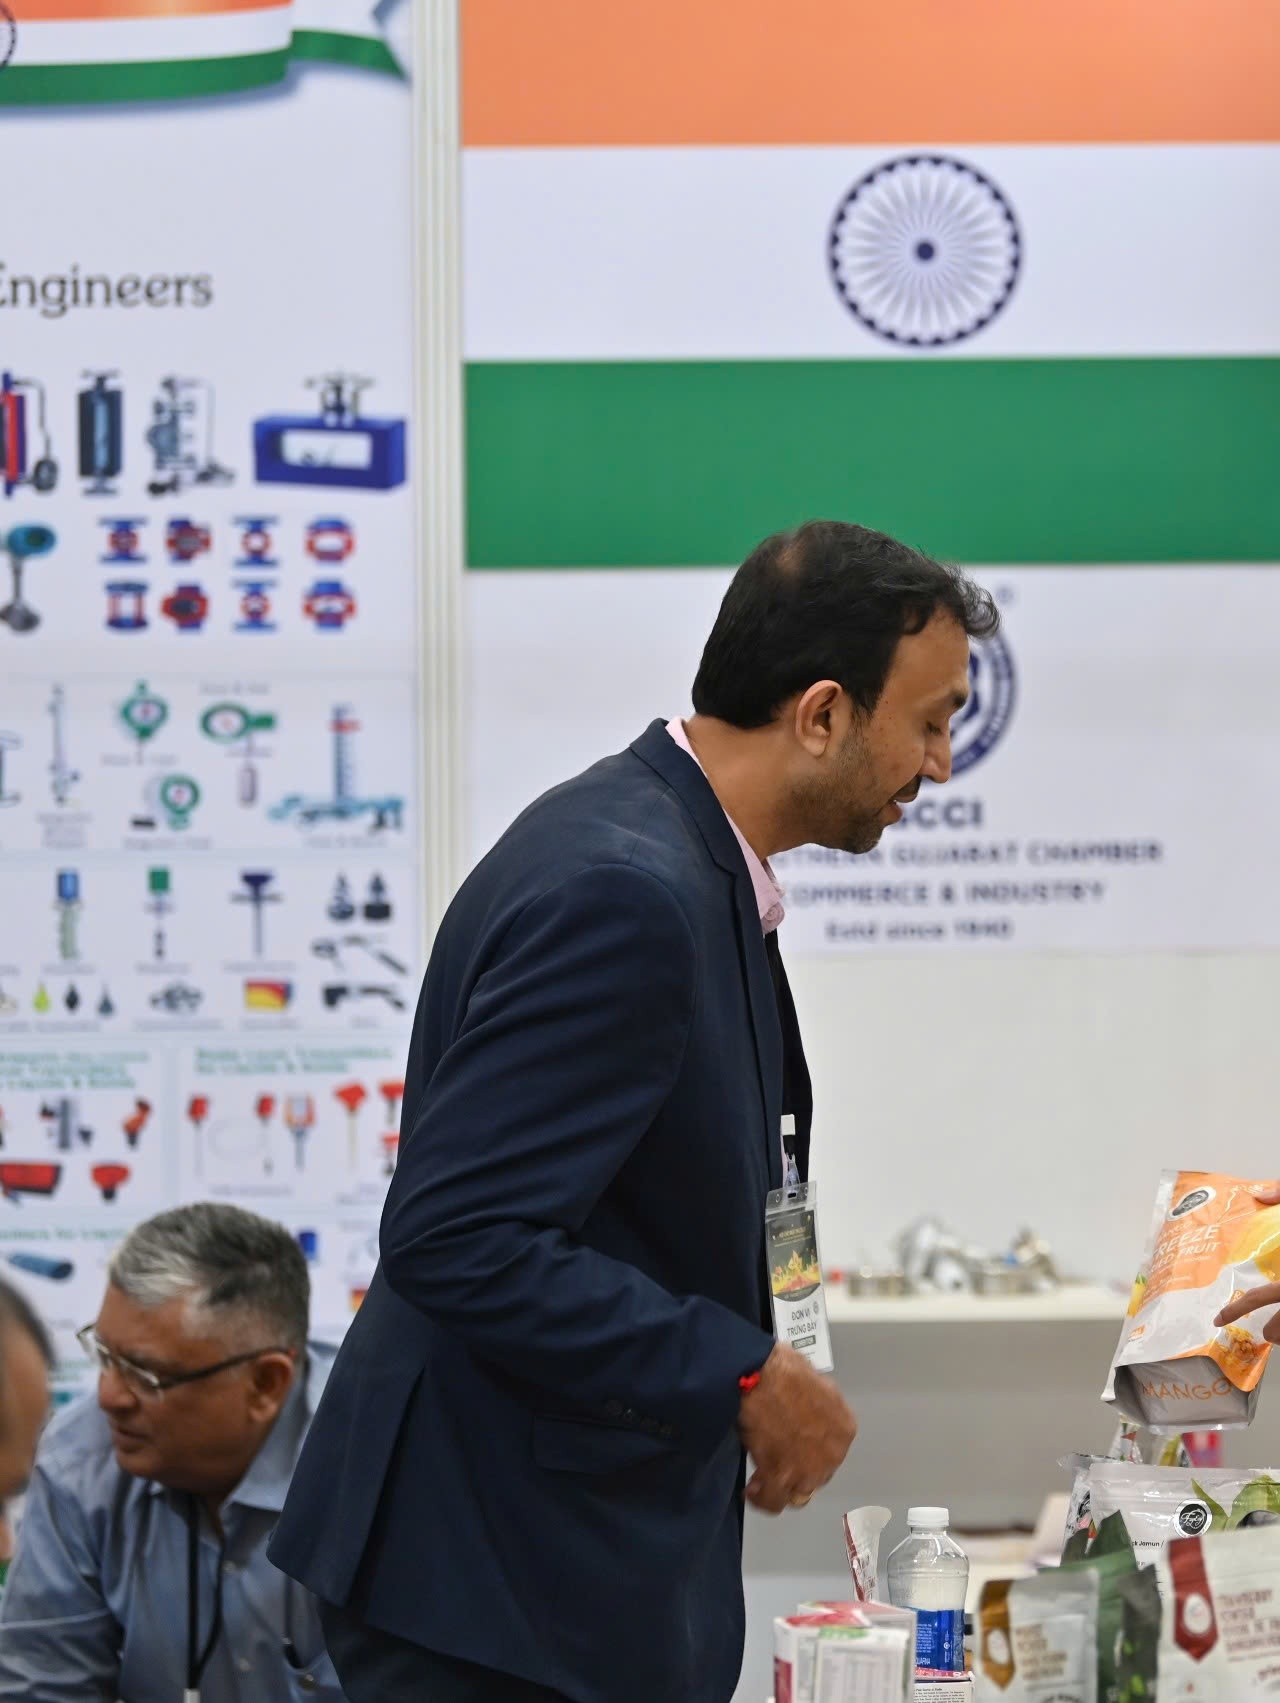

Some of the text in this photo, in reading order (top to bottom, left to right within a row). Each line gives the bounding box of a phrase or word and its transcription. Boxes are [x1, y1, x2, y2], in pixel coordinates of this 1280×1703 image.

[0, 260, 213, 319] ngineers
[890, 797, 984, 829] CCI
[1026, 838, 1163, 865] CHAMBER
[965, 880, 1105, 903] INDUSTRY
[1142, 1378, 1232, 1400] MANGO
